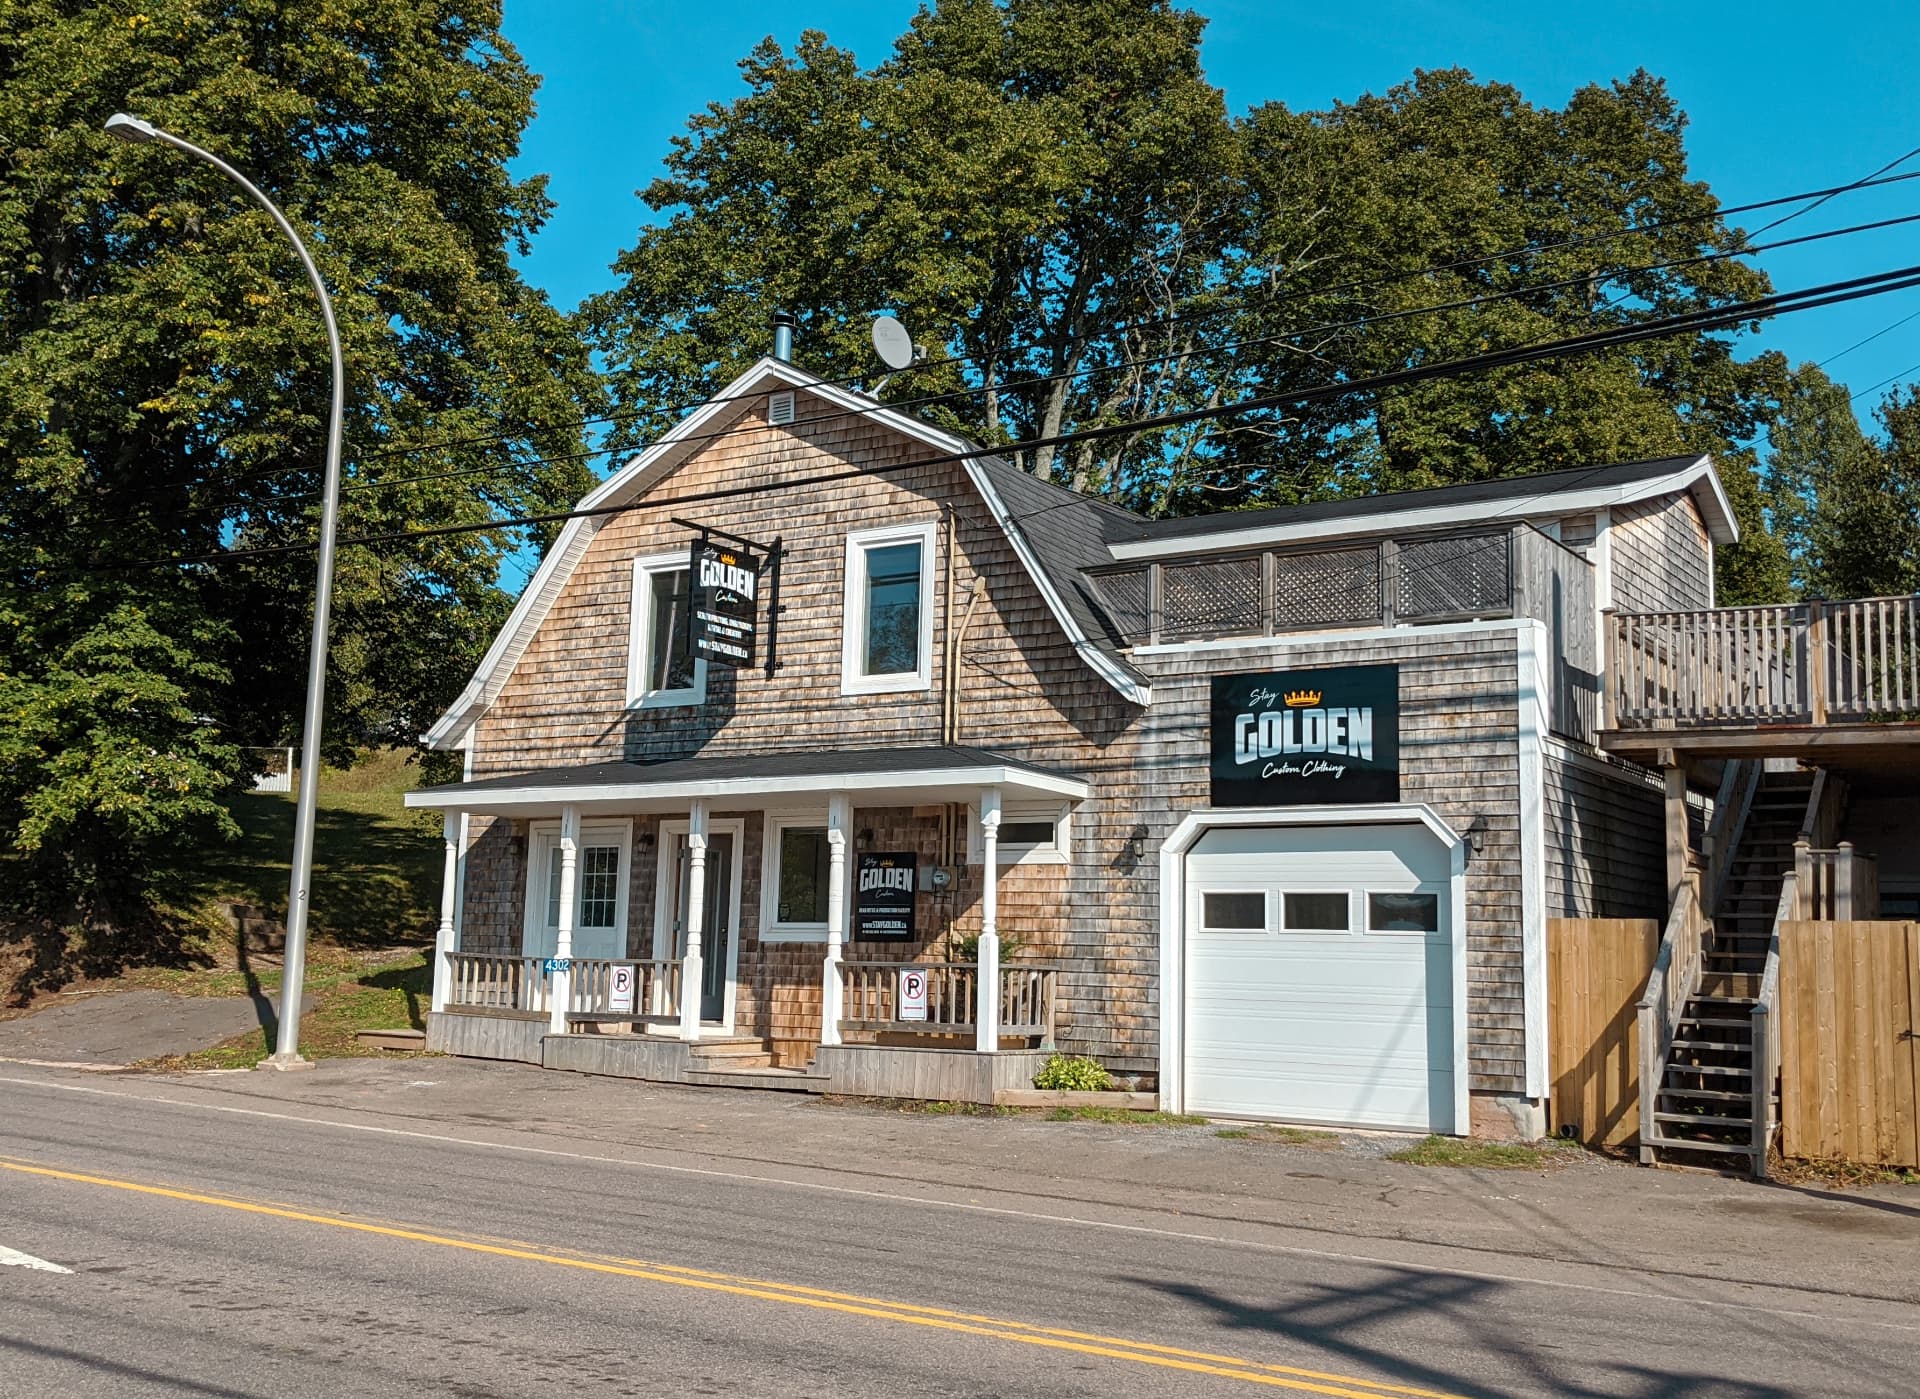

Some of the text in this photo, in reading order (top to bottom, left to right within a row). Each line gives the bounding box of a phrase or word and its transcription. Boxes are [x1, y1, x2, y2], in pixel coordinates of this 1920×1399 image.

[700, 558, 754, 601] GOLDEN
[1248, 688, 1280, 707] Stay
[1235, 707, 1373, 765] GOLDEN
[1262, 760, 1347, 779] Custom Clothing
[860, 867, 913, 892] GOLDEN
[298, 889, 306, 901] 2
[545, 959, 569, 971] 4302
[616, 972, 628, 989] P
[907, 978, 920, 995] P
